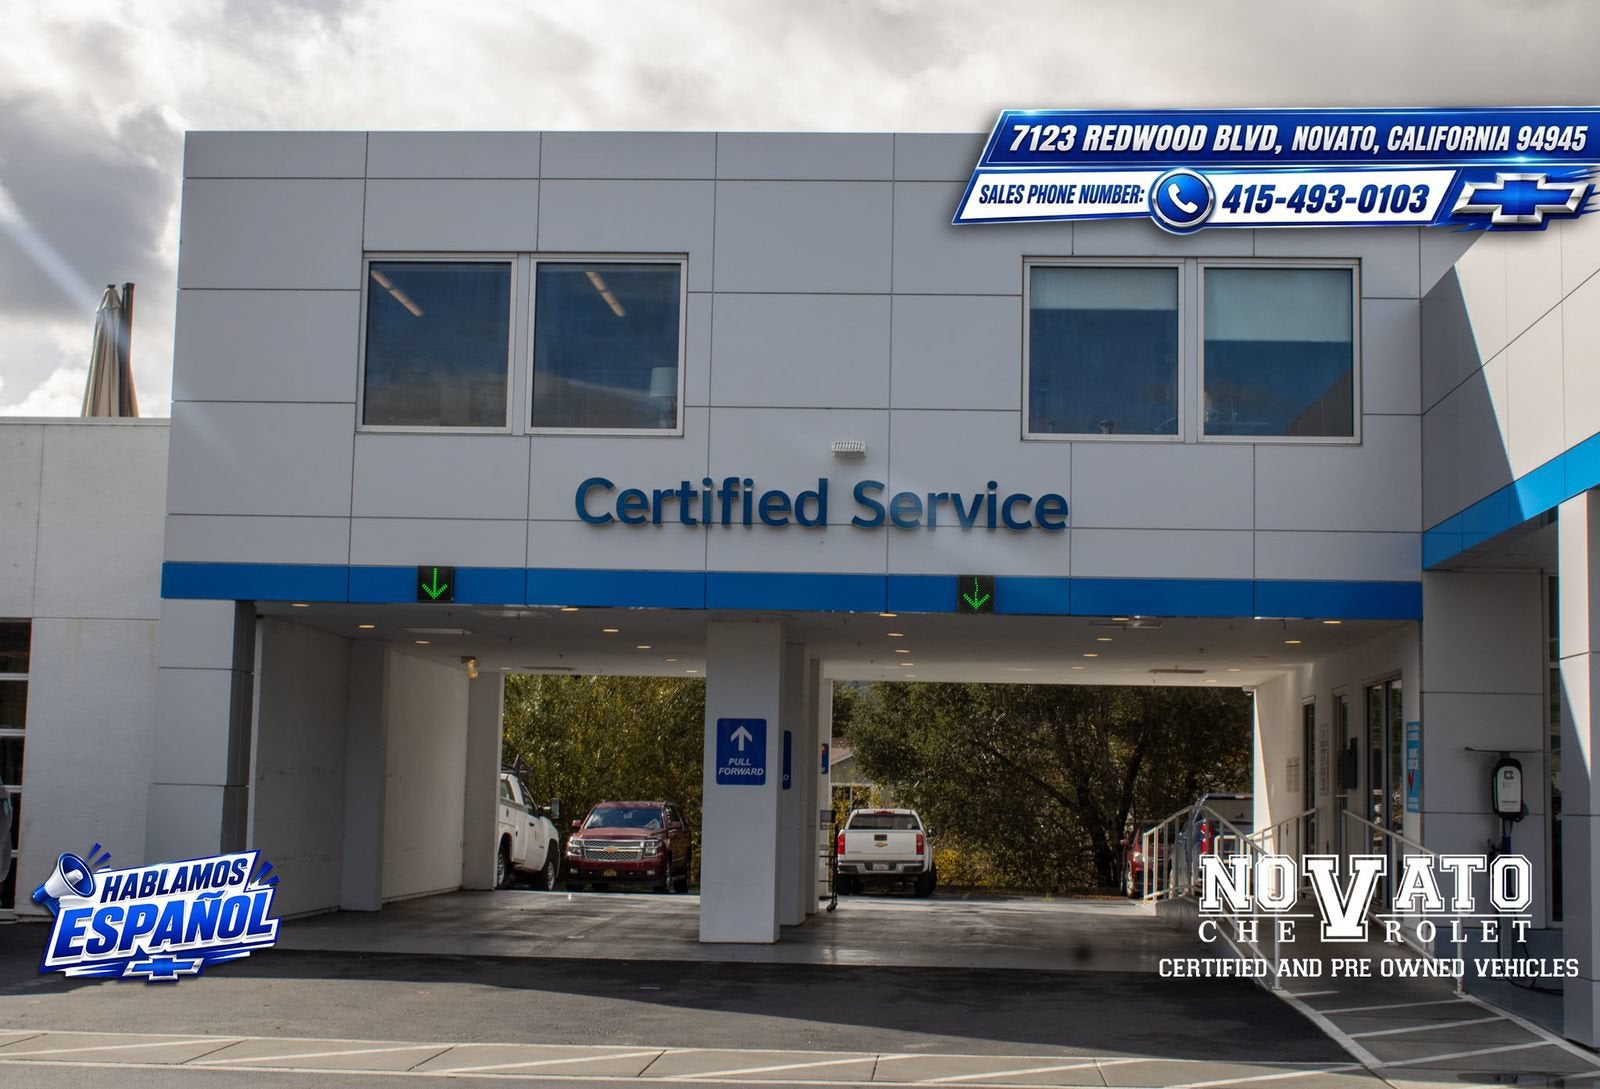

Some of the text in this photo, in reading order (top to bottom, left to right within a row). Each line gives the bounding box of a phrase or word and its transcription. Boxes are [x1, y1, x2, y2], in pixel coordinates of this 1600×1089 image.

[575, 476, 1069, 531] Certified Service
[728, 758, 752, 766] PULL
[718, 767, 764, 776] FORWARD
